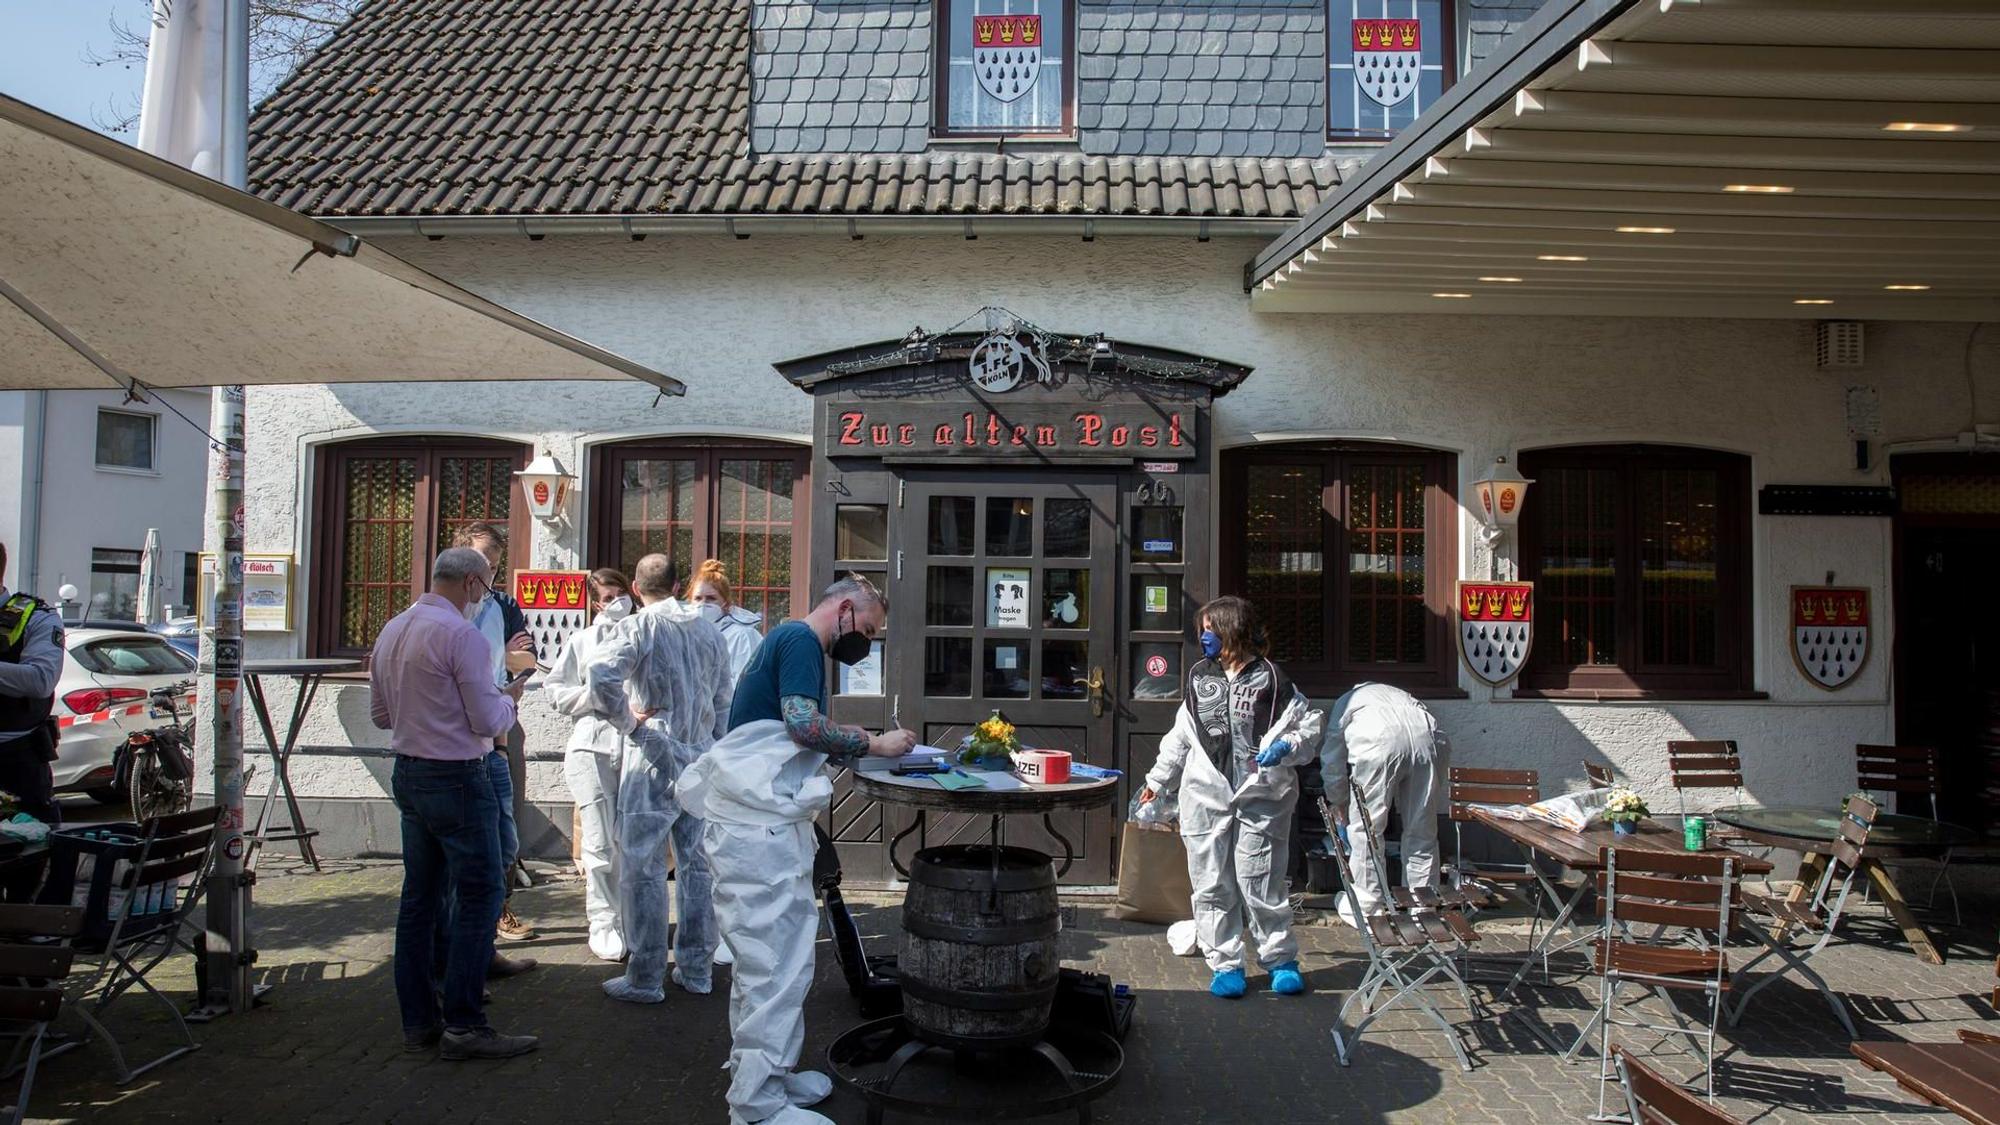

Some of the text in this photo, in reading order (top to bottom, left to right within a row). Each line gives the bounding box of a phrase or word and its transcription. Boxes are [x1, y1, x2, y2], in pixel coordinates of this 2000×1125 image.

[839, 411, 1184, 447] Zur alten Post
[993, 606, 1021, 614] Maske
